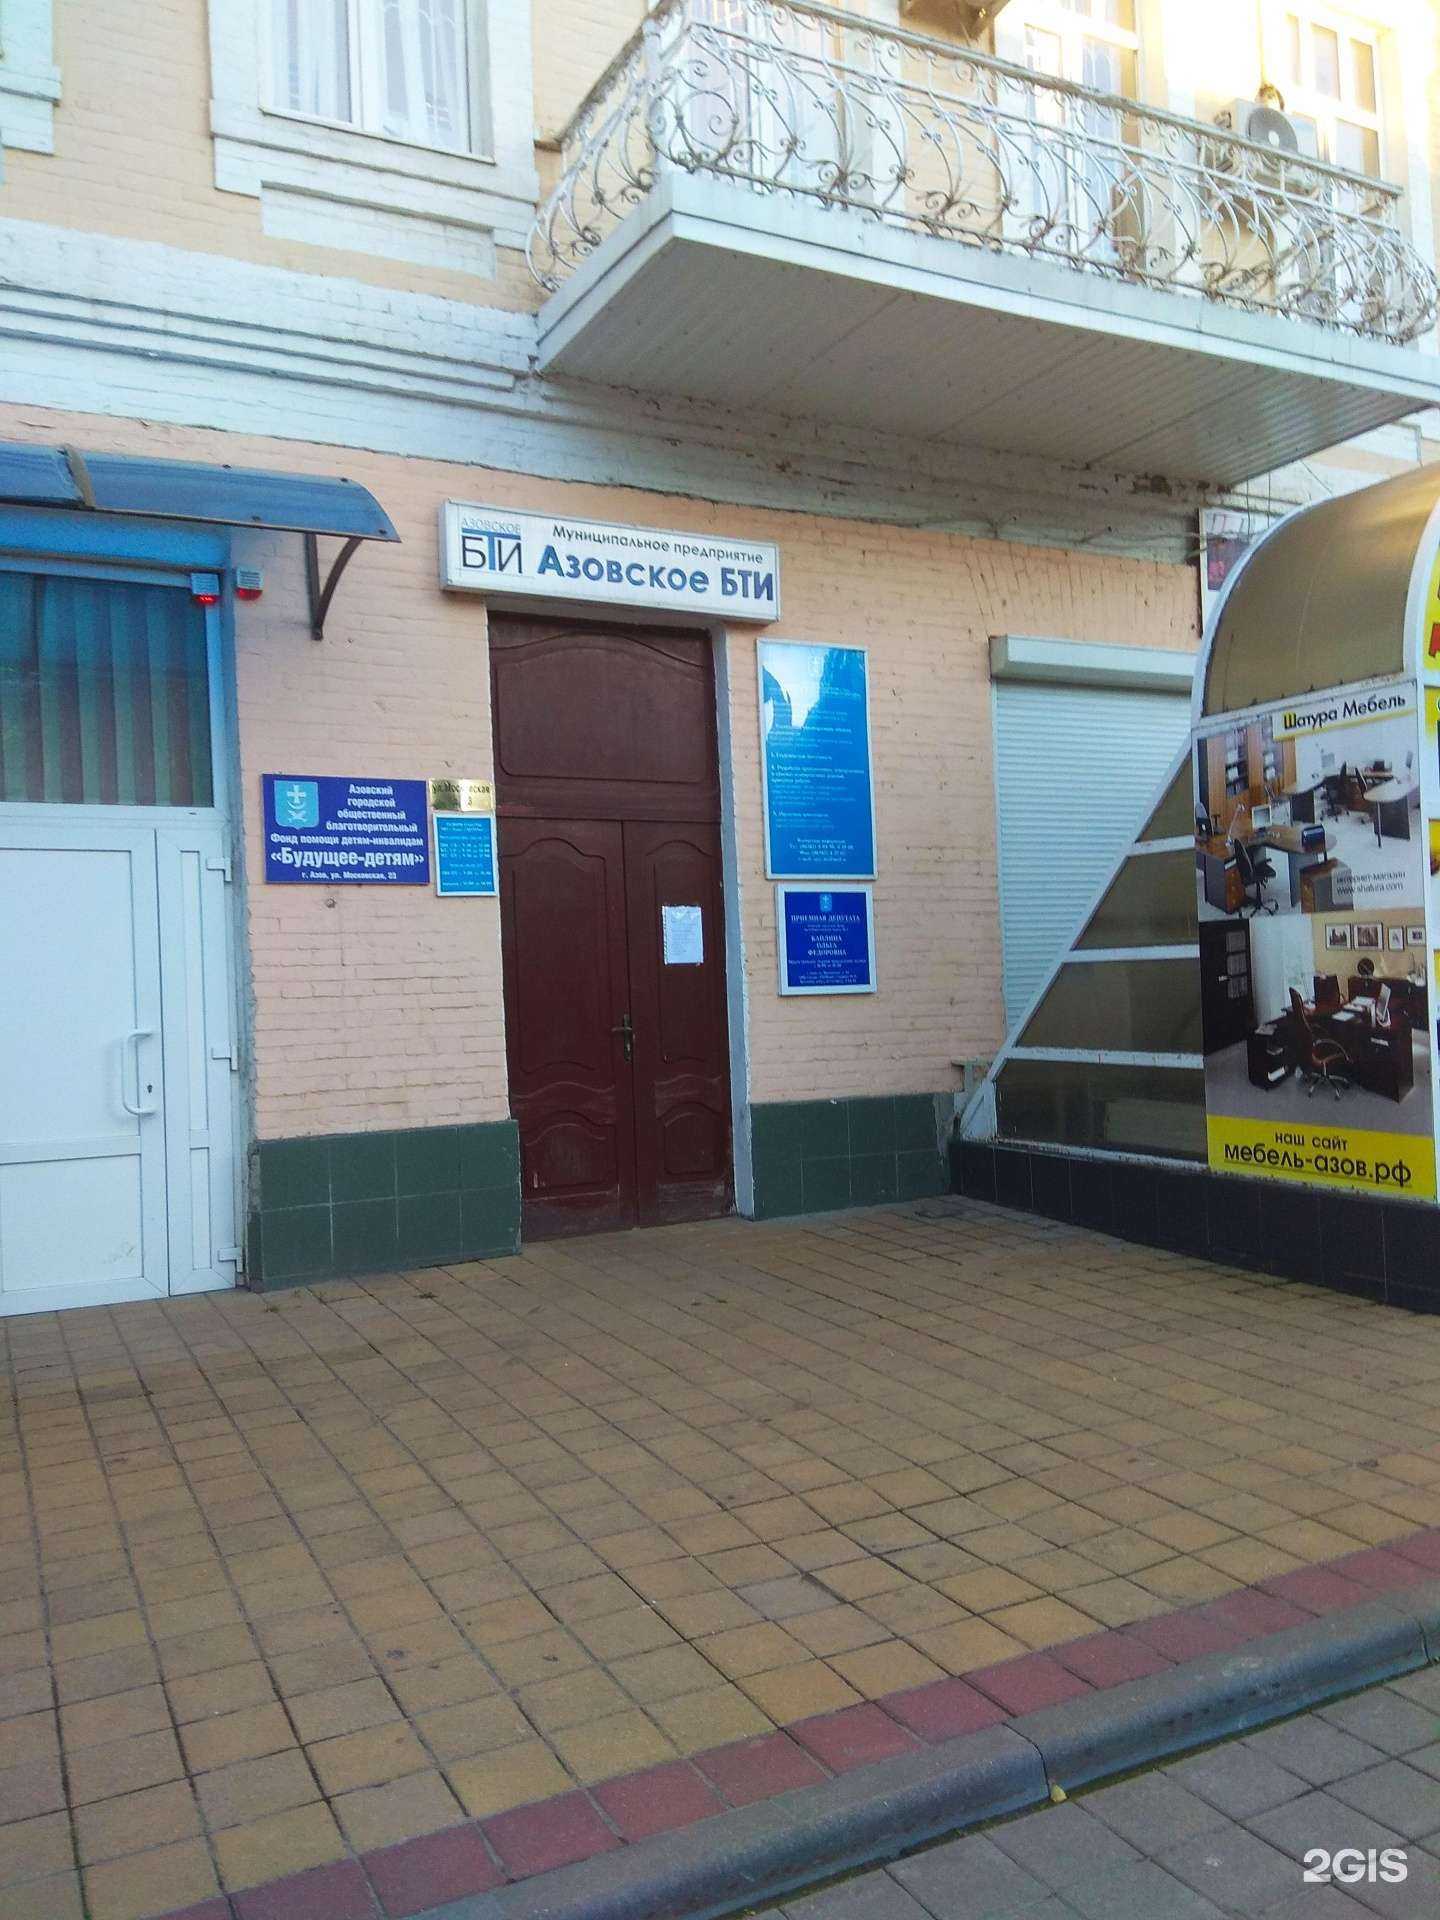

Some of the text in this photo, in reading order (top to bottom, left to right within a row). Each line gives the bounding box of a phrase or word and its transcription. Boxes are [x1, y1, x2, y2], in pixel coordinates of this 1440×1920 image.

[462, 517, 521, 533] АЗОВСКОЕ
[462, 528, 522, 574] БТИ
[552, 524, 764, 564] Муниципальное предприятие
[537, 545, 774, 601] Азовское БТИ
[1283, 694, 1406, 731] Шатура Мебель
[348, 783, 394, 796] Азовский
[347, 797, 396, 808] городской
[337, 808, 406, 820] общественный
[325, 821, 418, 833] благотворительный
[270, 833, 424, 847] Фонд помощи детям-инвалидам
[270, 846, 425, 868] «Будущее-детям»
[1275, 1131, 1348, 1151] наш сайт
[1224, 1143, 1412, 1188] мебель-азов.рф
